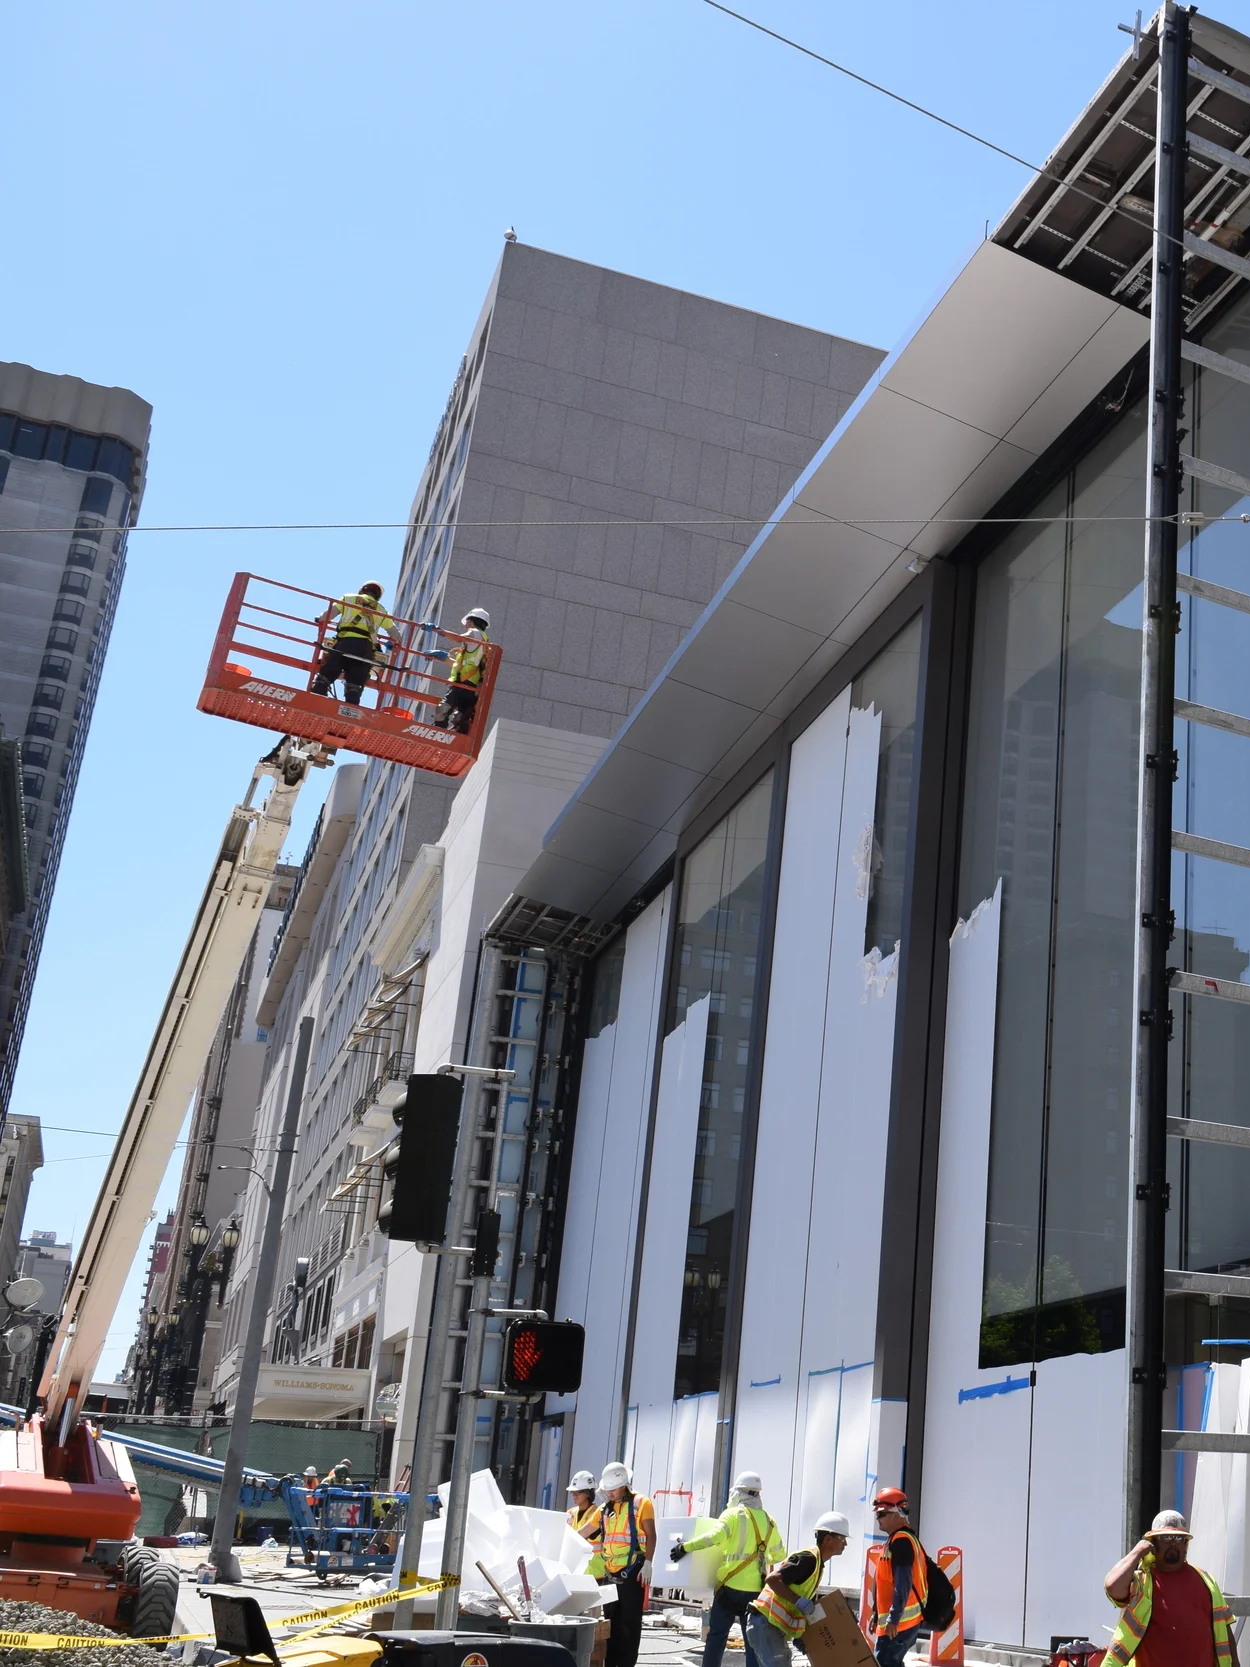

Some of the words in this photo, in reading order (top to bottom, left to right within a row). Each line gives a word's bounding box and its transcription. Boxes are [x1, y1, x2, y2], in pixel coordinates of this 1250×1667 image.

[238, 681, 297, 703] AHERN
[401, 725, 456, 745] AHERN
[273, 1379, 354, 1391] WILLIAMS-SONOMA
[355, 1593, 399, 1611] CAUTION
[282, 1610, 328, 1627] CAUTION
[0, 1633, 29, 1646] TION
